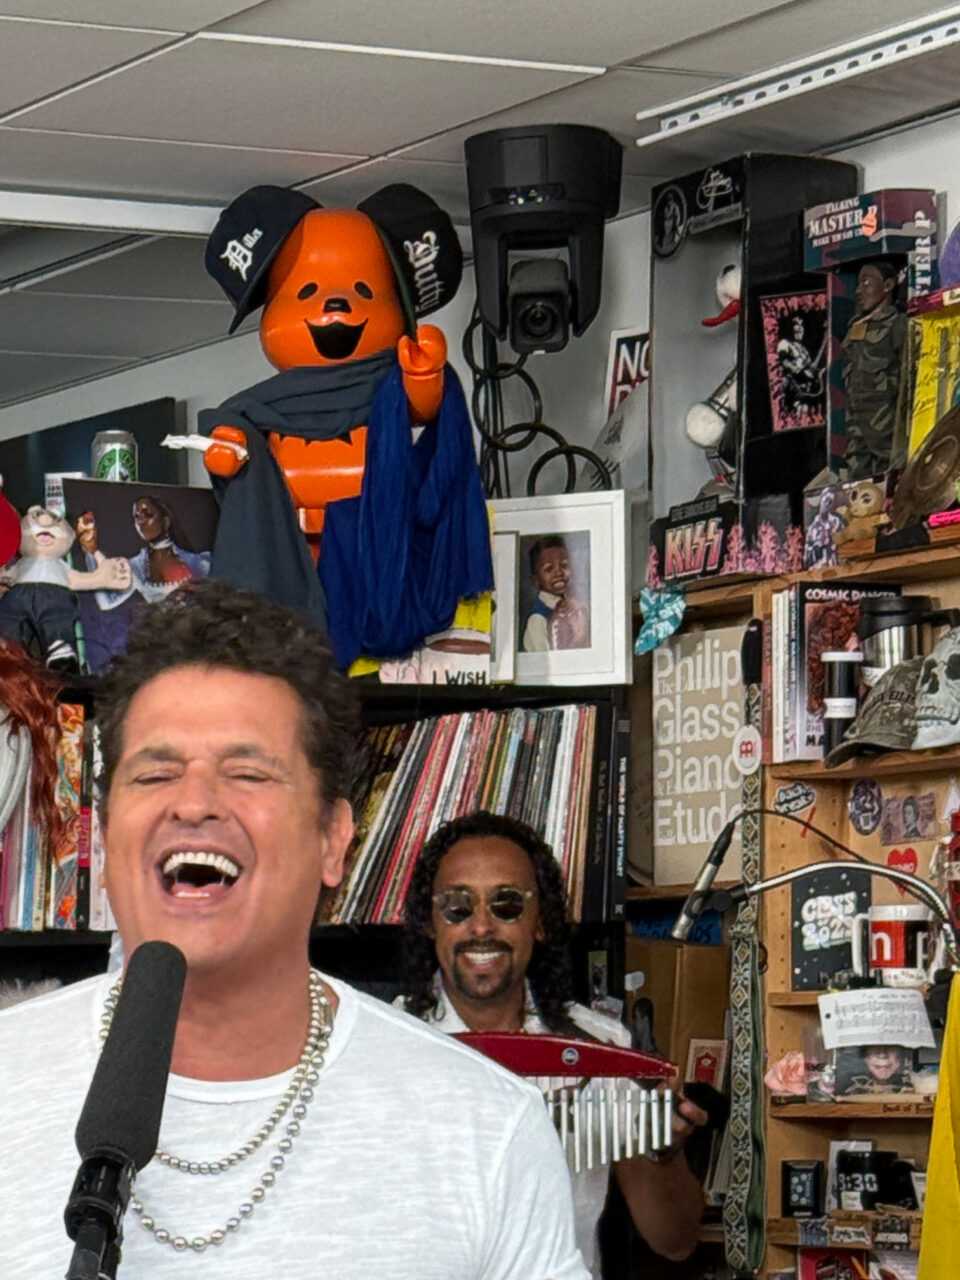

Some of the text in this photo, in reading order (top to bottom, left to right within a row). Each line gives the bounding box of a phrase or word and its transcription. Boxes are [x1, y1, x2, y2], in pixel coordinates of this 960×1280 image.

[808, 208, 865, 239] MASTER
[665, 517, 724, 580] KISS
[805, 588, 851, 600] COSMIC
[445, 670, 487, 686] WISH
[654, 637, 741, 700] Philip
[653, 694, 741, 746] Glass
[653, 746, 741, 796] Piano
[618, 804, 625, 816] OF
[654, 791, 743, 847] Etude
[801, 891, 858, 922] CLASS
